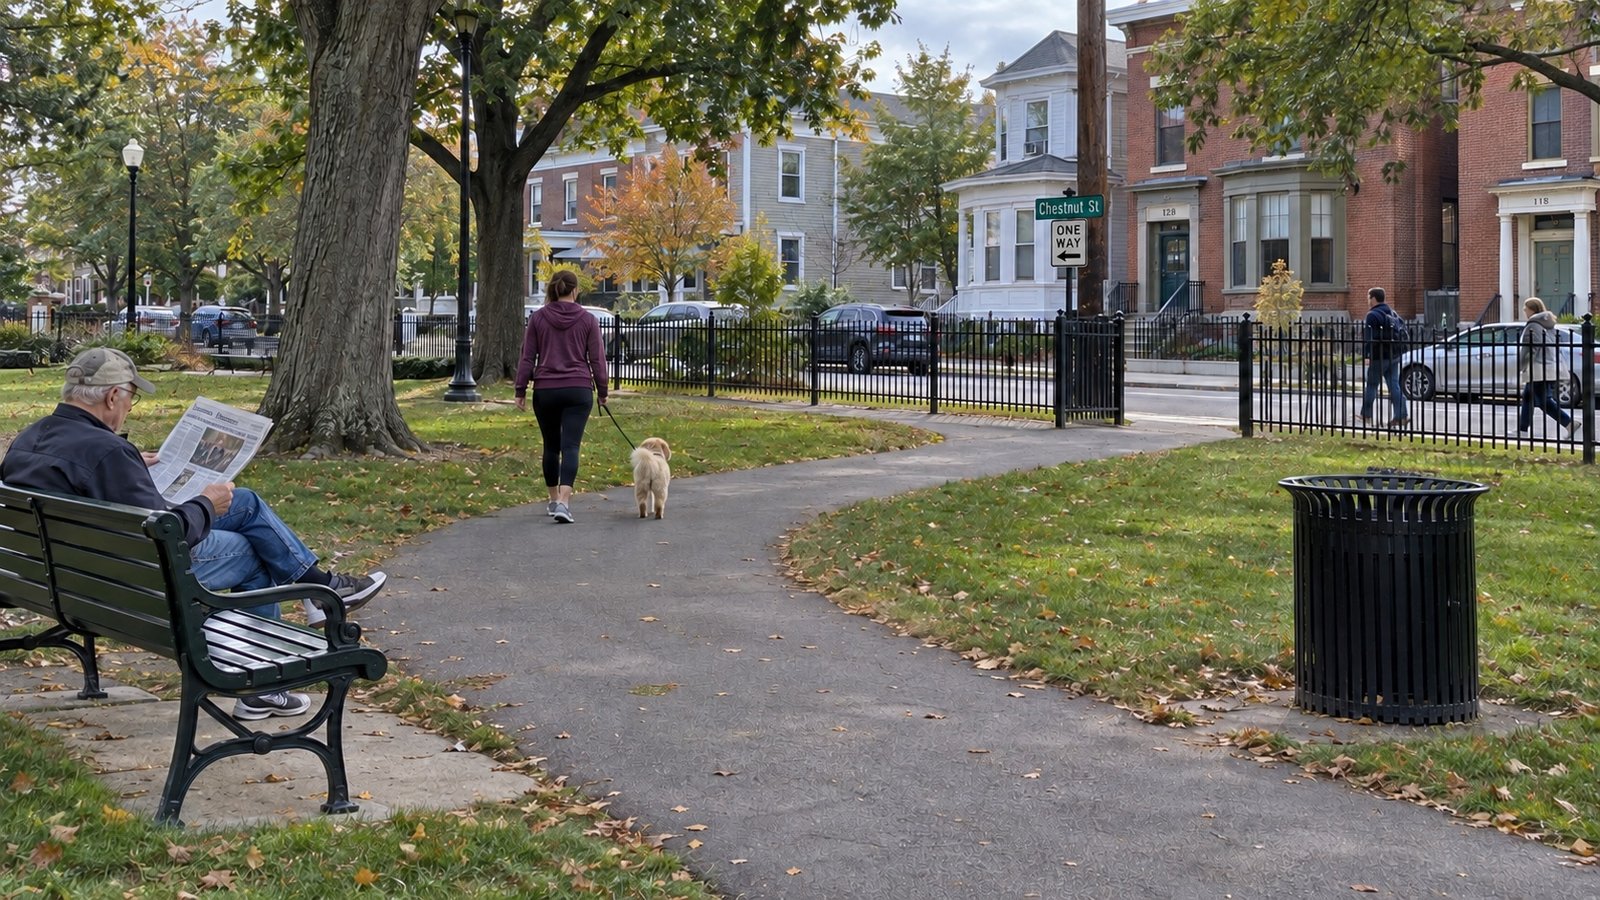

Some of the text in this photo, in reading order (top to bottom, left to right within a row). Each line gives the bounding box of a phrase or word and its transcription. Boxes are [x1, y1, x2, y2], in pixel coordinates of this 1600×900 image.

[1534, 197, 1549, 205] 118
[1039, 200, 1100, 215] Chestnut St
[1162, 208, 1176, 216] 128
[1056, 225, 1081, 235] ONE
[1056, 238, 1081, 248] WAY
